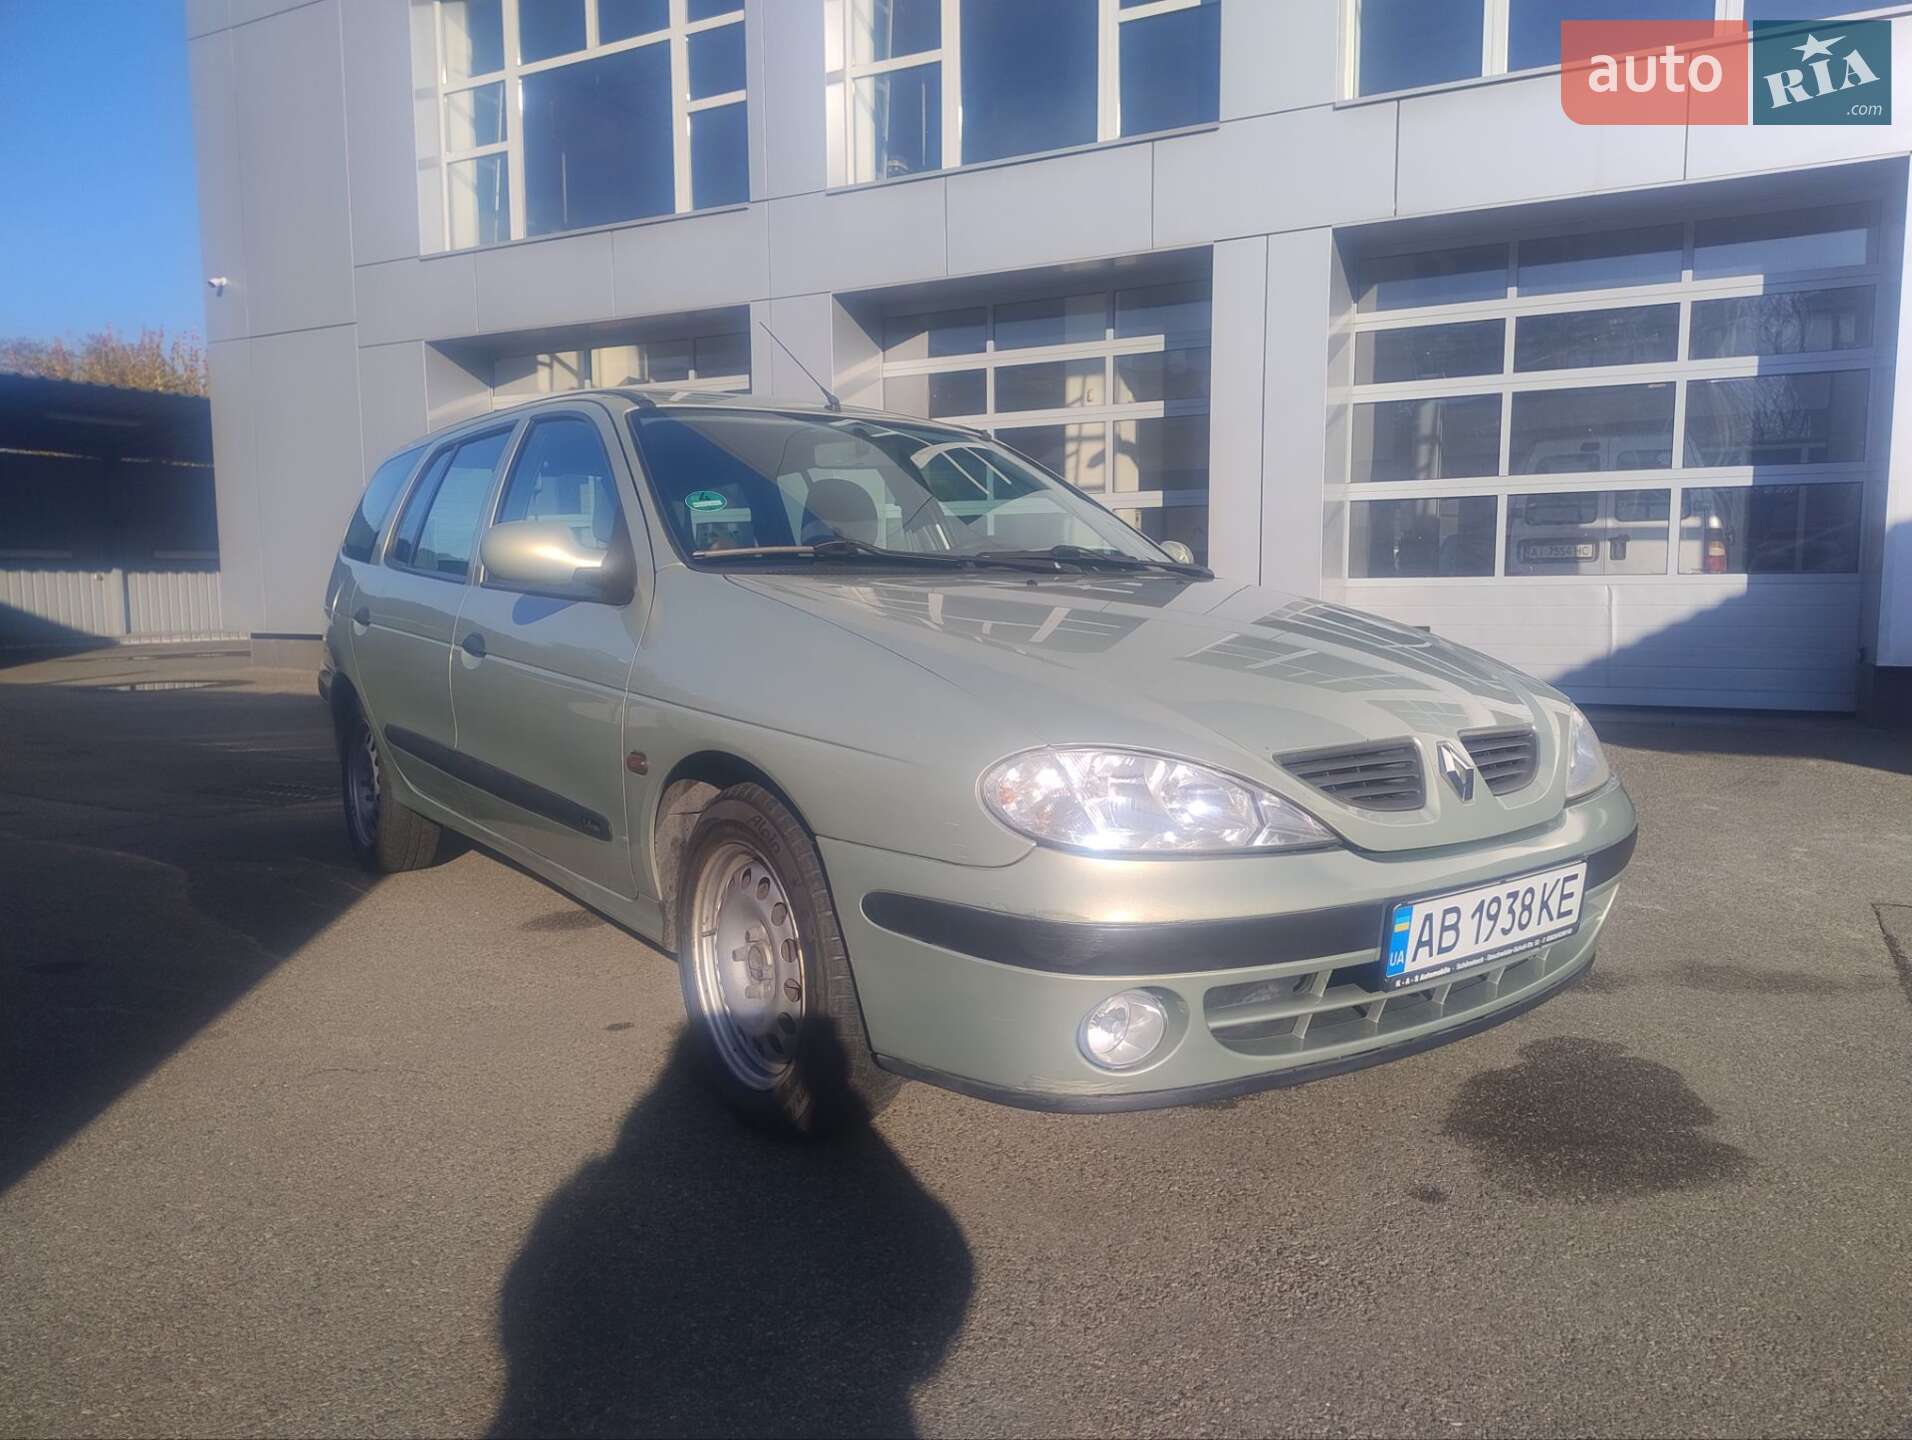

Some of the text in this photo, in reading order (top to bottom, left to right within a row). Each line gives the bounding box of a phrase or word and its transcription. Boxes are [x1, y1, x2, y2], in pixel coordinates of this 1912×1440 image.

[1411, 907, 1461, 962] AB
[1471, 886, 1534, 945] 1938
[1537, 873, 1579, 926] KE
[1390, 951, 1404, 966] UA
